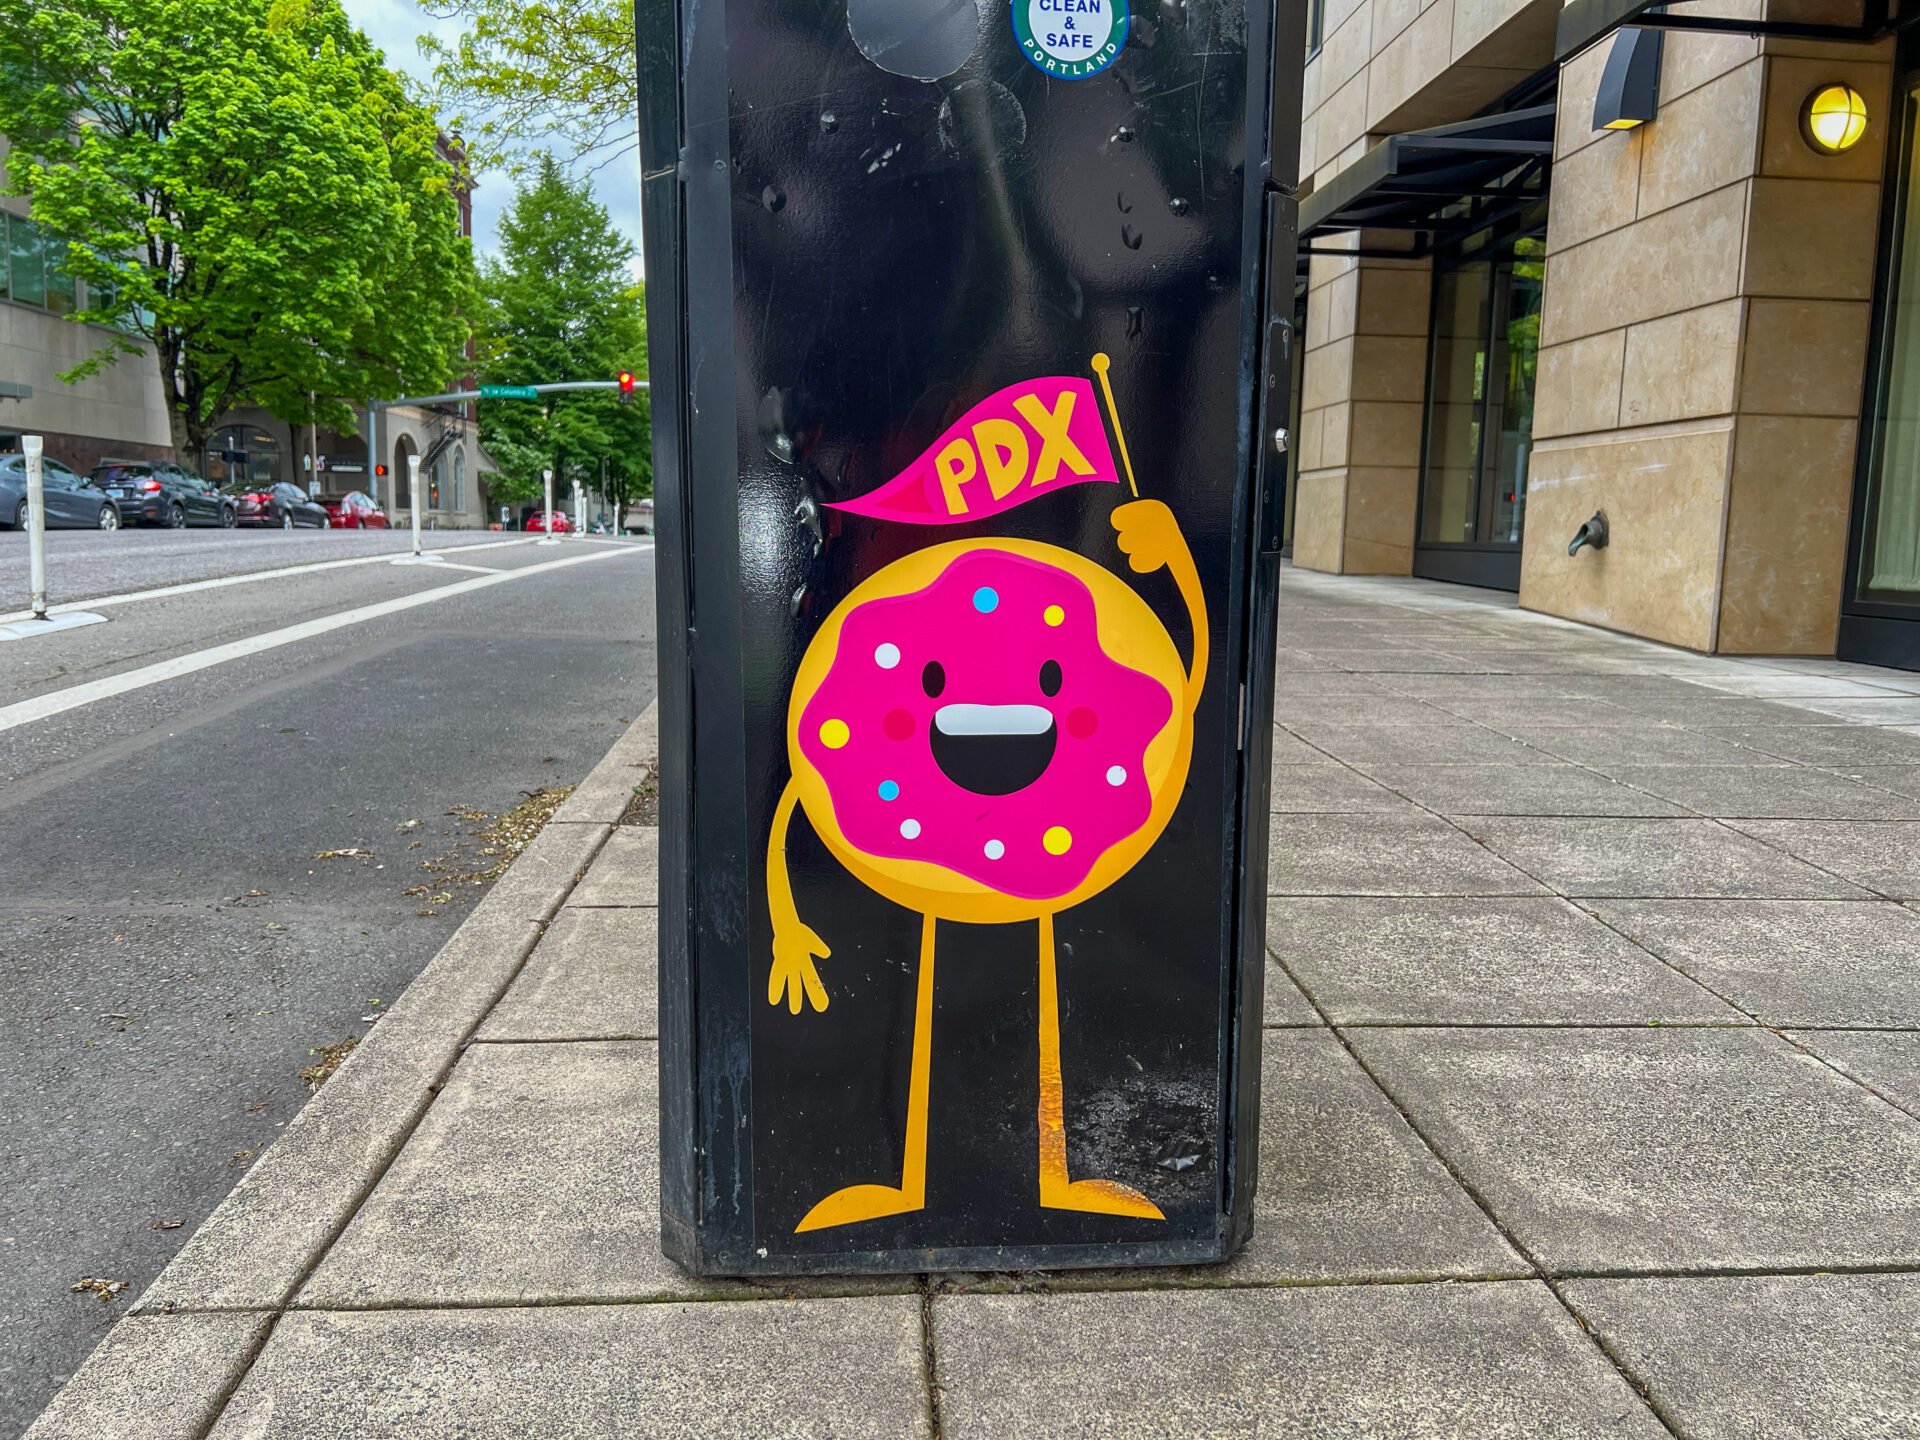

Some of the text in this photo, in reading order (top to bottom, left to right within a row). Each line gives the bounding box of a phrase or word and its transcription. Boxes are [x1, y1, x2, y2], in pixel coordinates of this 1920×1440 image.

[1039, 0, 1101, 13] CLEAN
[1064, 16, 1076, 30] &
[1046, 33, 1093, 48] SAFE
[1023, 38, 1117, 75] PORTLAND
[935, 391, 1097, 515] PDX
